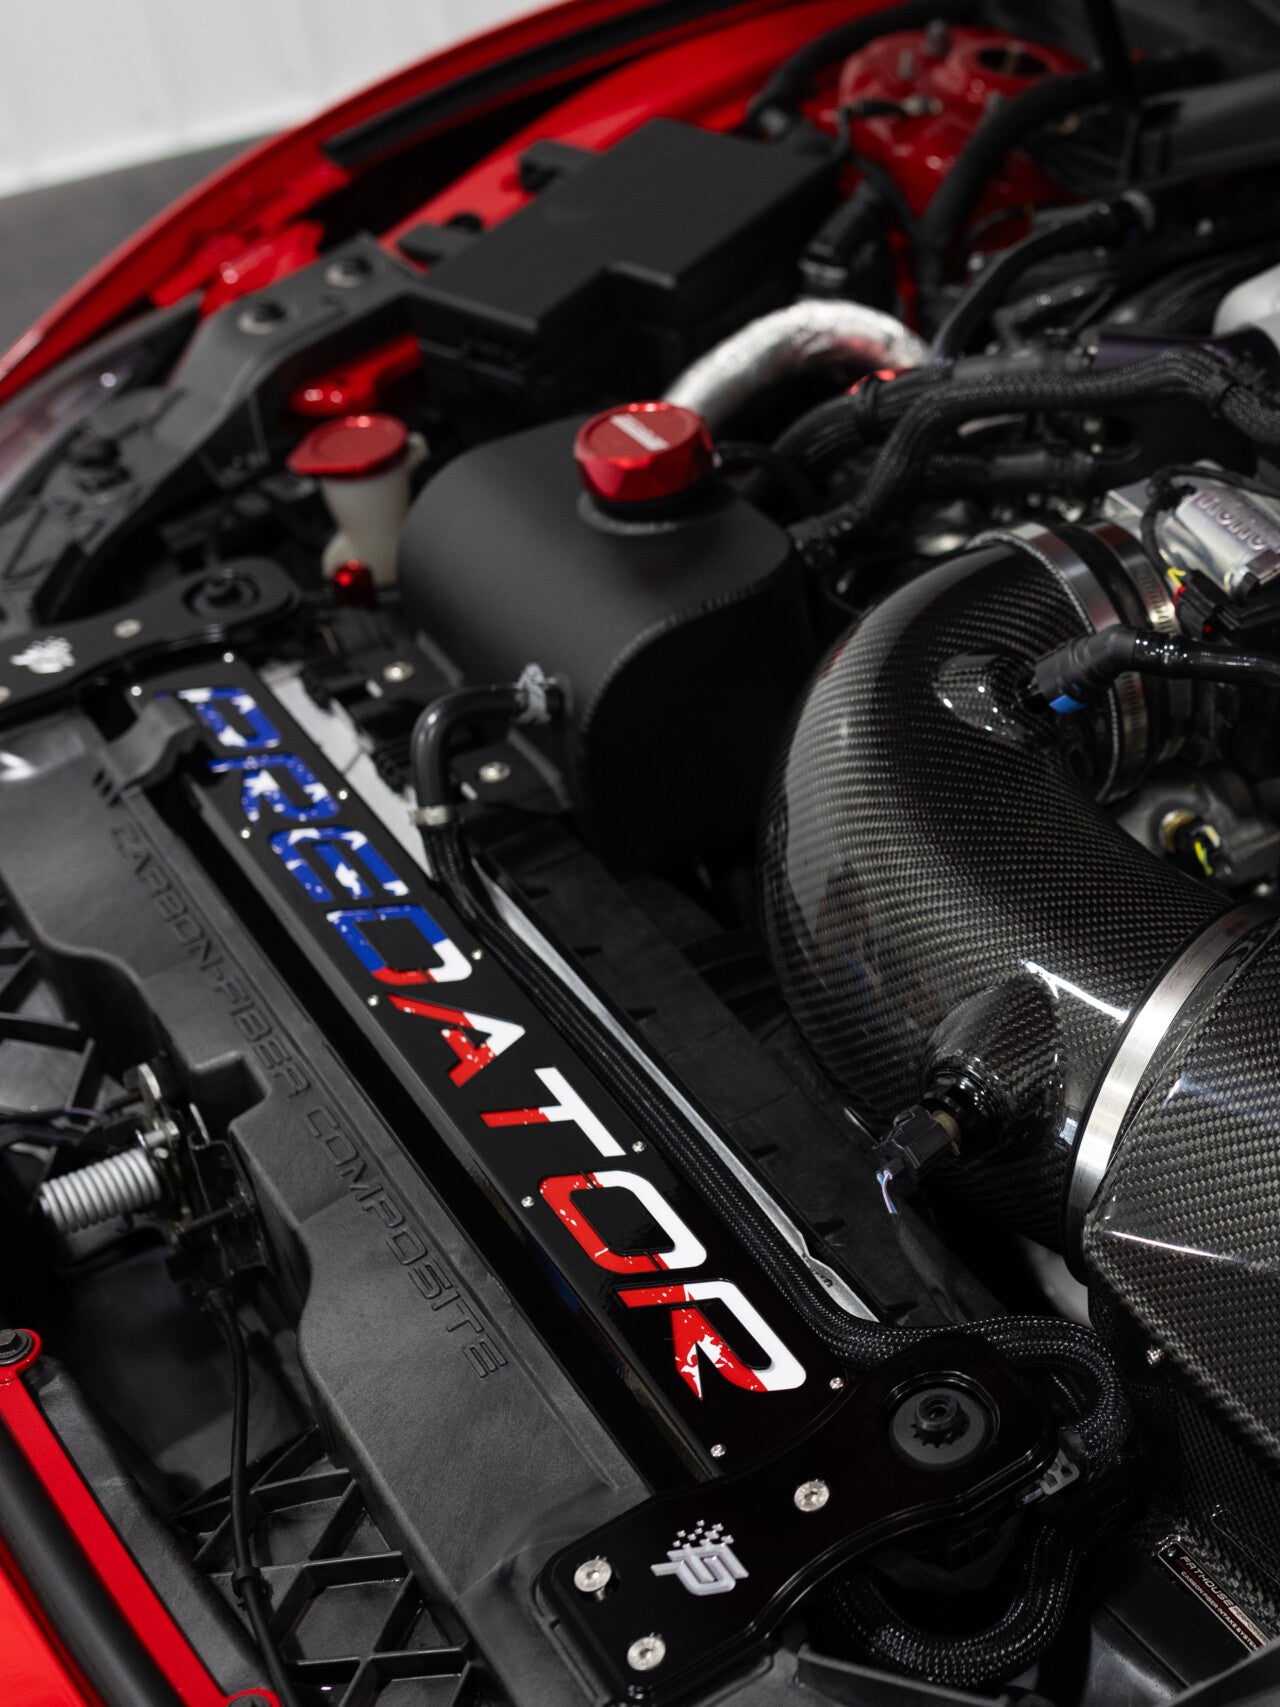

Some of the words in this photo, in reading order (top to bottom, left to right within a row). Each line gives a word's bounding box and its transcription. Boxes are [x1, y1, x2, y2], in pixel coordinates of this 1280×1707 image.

[156, 686, 807, 1399] PREDATOR
[304, 1104, 509, 1379] COMPOSITE
[1180, 1555, 1234, 1607] FATHOUSE
[1180, 1570, 1204, 1594] CARBON
[1202, 1592, 1219, 1608] FIBER
[1217, 1607, 1238, 1629] INTAKE
